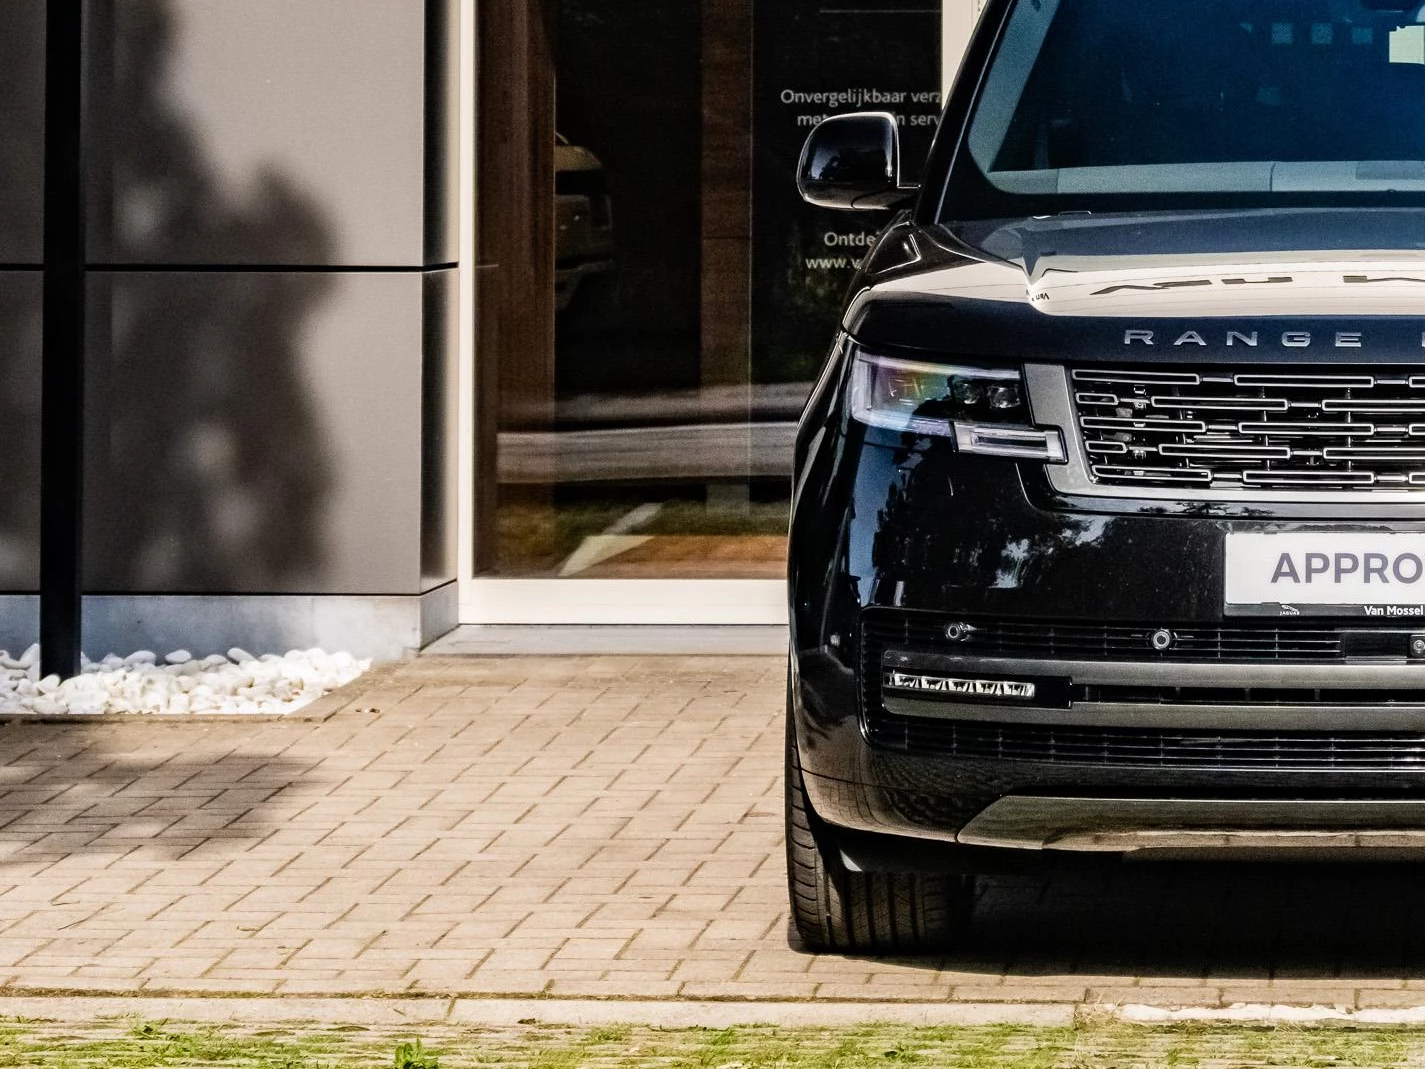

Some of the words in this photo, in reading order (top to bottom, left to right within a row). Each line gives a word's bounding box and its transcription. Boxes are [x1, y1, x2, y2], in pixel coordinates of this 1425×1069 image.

[780, 88, 906, 108] Onvergelijkbaar
[910, 92, 942, 104] verz
[910, 114, 940, 126] serv
[824, 231, 880, 247] Ontde
[805, 258, 862, 270] www.v
[1123, 330, 1362, 348] RANGE
[1364, 605, 1384, 616] Van
[1386, 604, 1424, 616] Mossel
